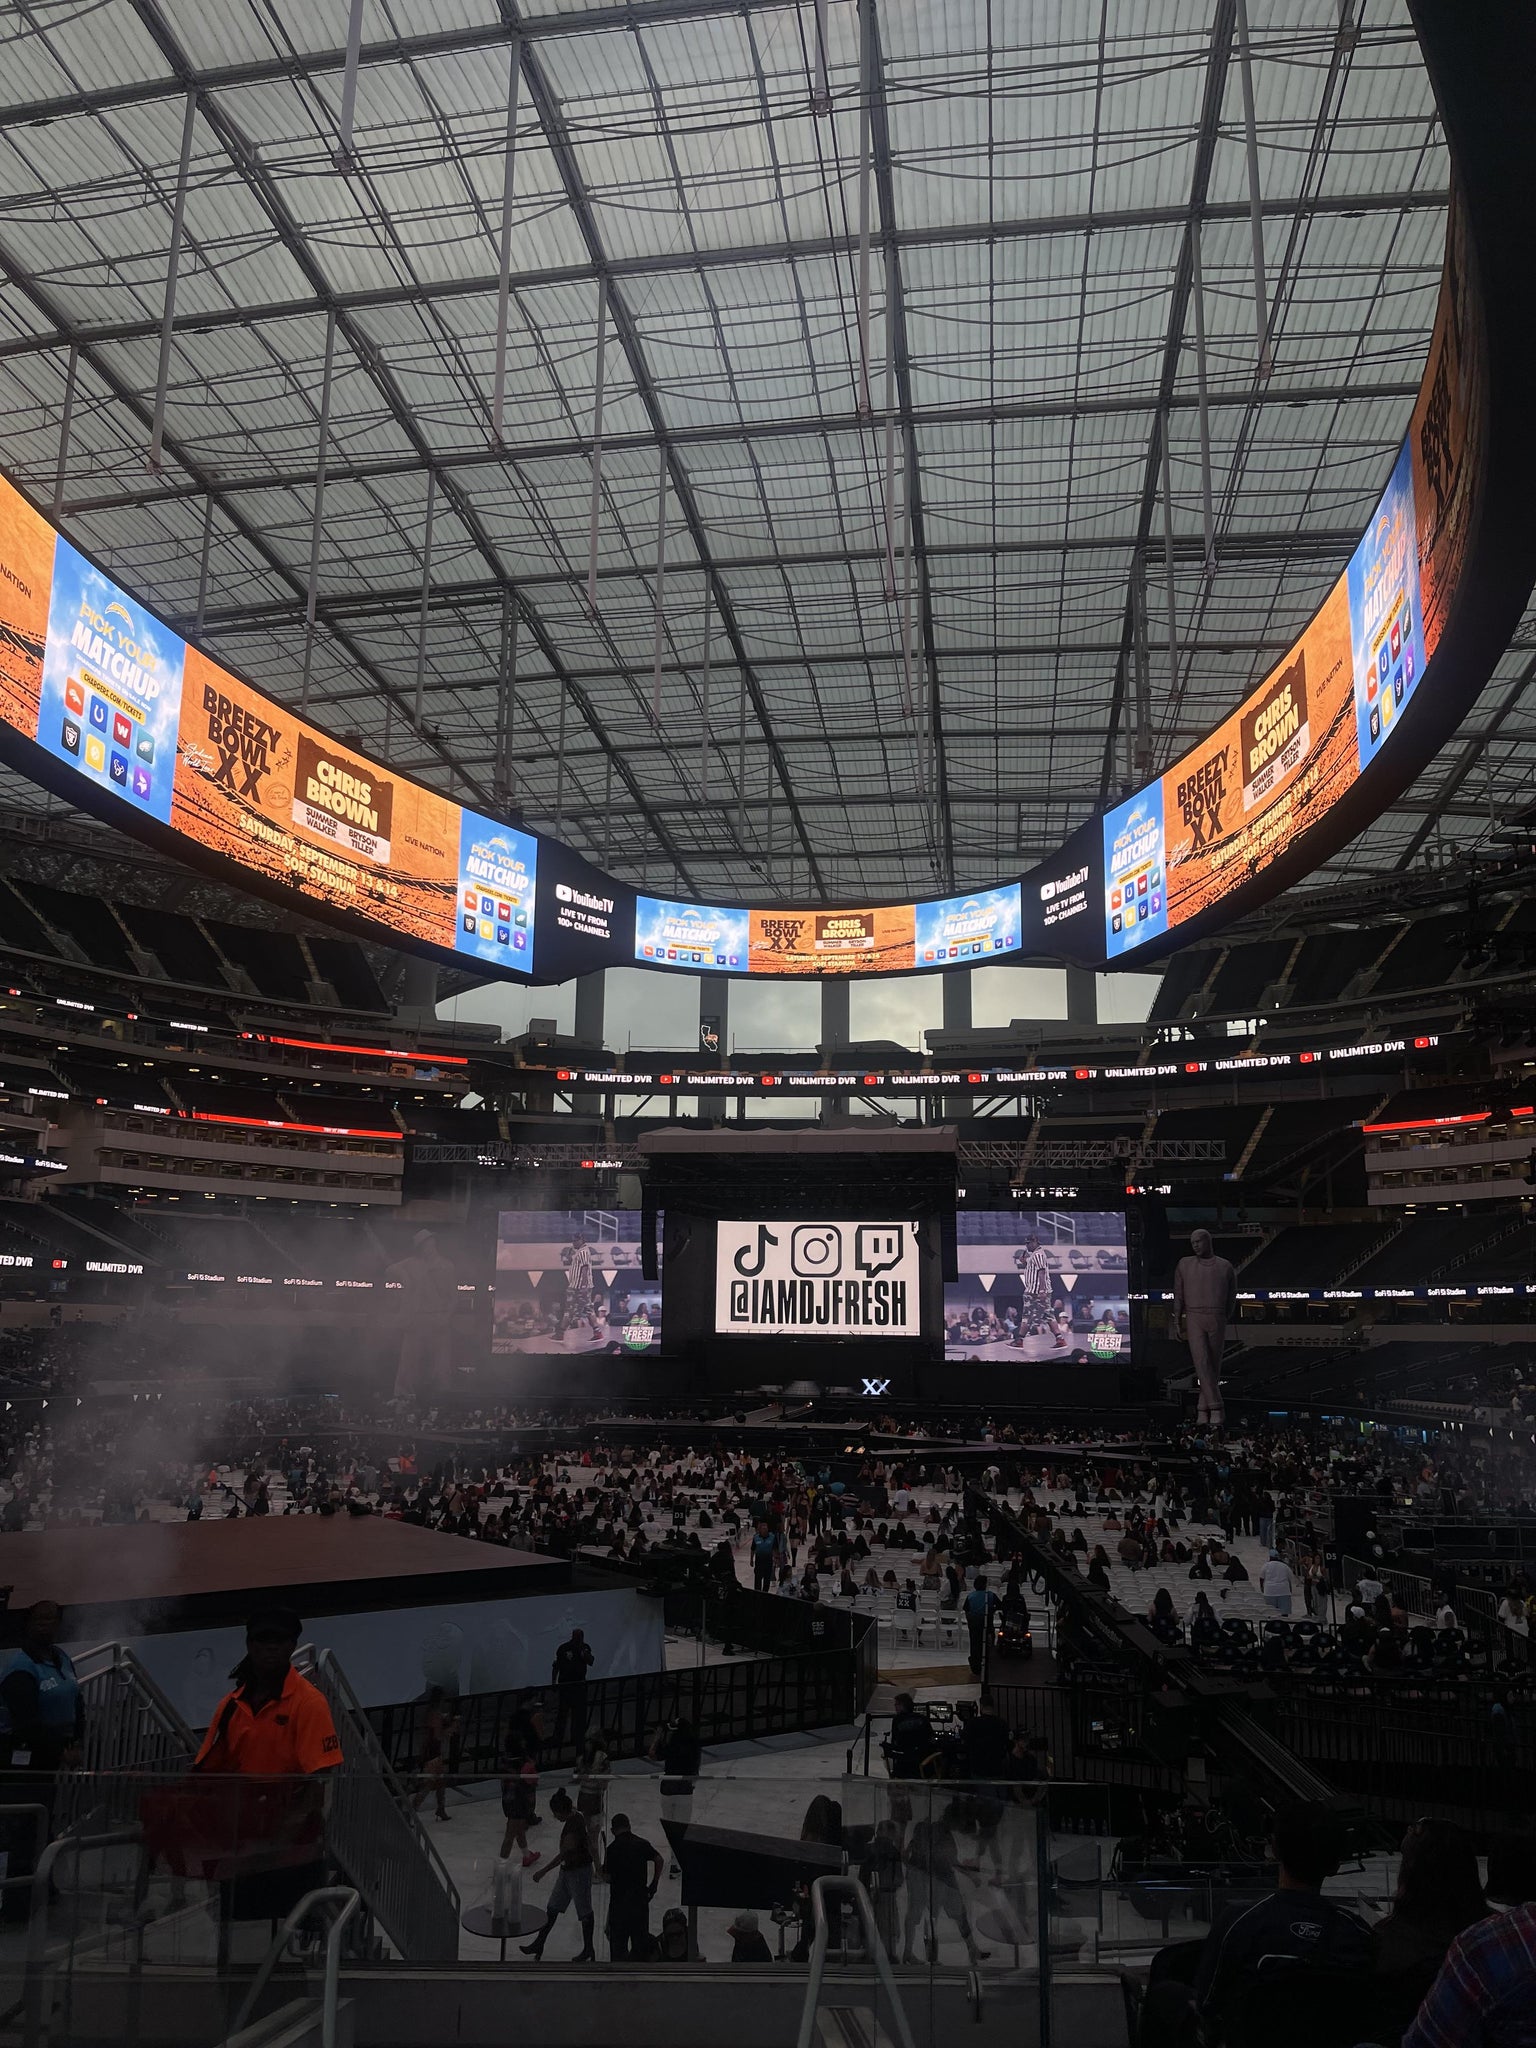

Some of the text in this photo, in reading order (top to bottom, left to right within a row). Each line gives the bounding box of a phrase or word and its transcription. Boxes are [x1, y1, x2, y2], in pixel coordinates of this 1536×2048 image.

[0, 563, 32, 599] NATION
[80, 601, 115, 641] PICK
[118, 631, 157, 672] YOUR
[71, 620, 160, 701] MATCHUP
[84, 673, 142, 720] CHARGERS.COM/TICKETS
[1254, 684, 1291, 741] CHRIS
[203, 684, 282, 753] BREEZY
[208, 714, 271, 775] BOWL
[1250, 704, 1299, 774] BROWN
[316, 761, 372, 805] CHRIS
[1177, 744, 1230, 808] BREEZY
[1253, 752, 1300, 800] WALKER TILLER
[307, 777, 378, 832] BROWN
[1183, 778, 1227, 827] BOWL
[1251, 798, 1293, 839] SEPTEMBER
[1293, 785, 1303, 803] 13
[306, 808, 377, 848] SUMMER BRYSON
[307, 817, 374, 856] WALKER TILLER
[1113, 817, 1156, 852] PICK YOUR
[1243, 813, 1293, 866] SOFI STADIUM
[239, 814, 297, 853] SATURDAY,
[299, 842, 358, 882] SEPTEMBER
[360, 870, 373, 889] 13
[420, 841, 445, 858] NATION
[471, 844, 525, 873] PICK YOUR
[1111, 828, 1159, 873] MATCHUP
[284, 855, 356, 896] SOFI STADIUM
[466, 855, 529, 892] MATCHUP
[560, 907, 608, 927] LIVE TV FROM
[1046, 890, 1085, 914] LIVE TV FROM
[1059, 901, 1088, 922] CHANNELS
[574, 921, 611, 938] CHANNELS
[662, 925, 720, 942] MATCHUP
[761, 920, 805, 929] BREEZY
[765, 928, 801, 937] BOWL
[822, 928, 866, 938] BROWN
[827, 919, 861, 929] CHRIS
[944, 915, 998, 937] MATCHUP
[569, 1036, 1438, 1085] TV UNLIMITED DVR TV UNLIMITED DVR TV UNLIMITED DVR TV UNLIMITED DVR TV UNLIMITED DVR TV UNLIMITED DVR TV UNLIMITED DVR TV UNLIMITED DVR TV
[958, 1188, 966, 1197] TV
[15, 1256, 33, 1267] DVR
[86, 1262, 127, 1273] UNLIMITED
[128, 1265, 143, 1274] DVR
[204, 1274, 225, 1282] Stadium
[730, 1280, 906, 1325] @IAMDJFRESH
[627, 1329, 653, 1340] FRESH
[1094, 1337, 1121, 1347] FRESH
[861, 1378, 891, 1396] XX
[1299, 1924, 1321, 1938] Ford
